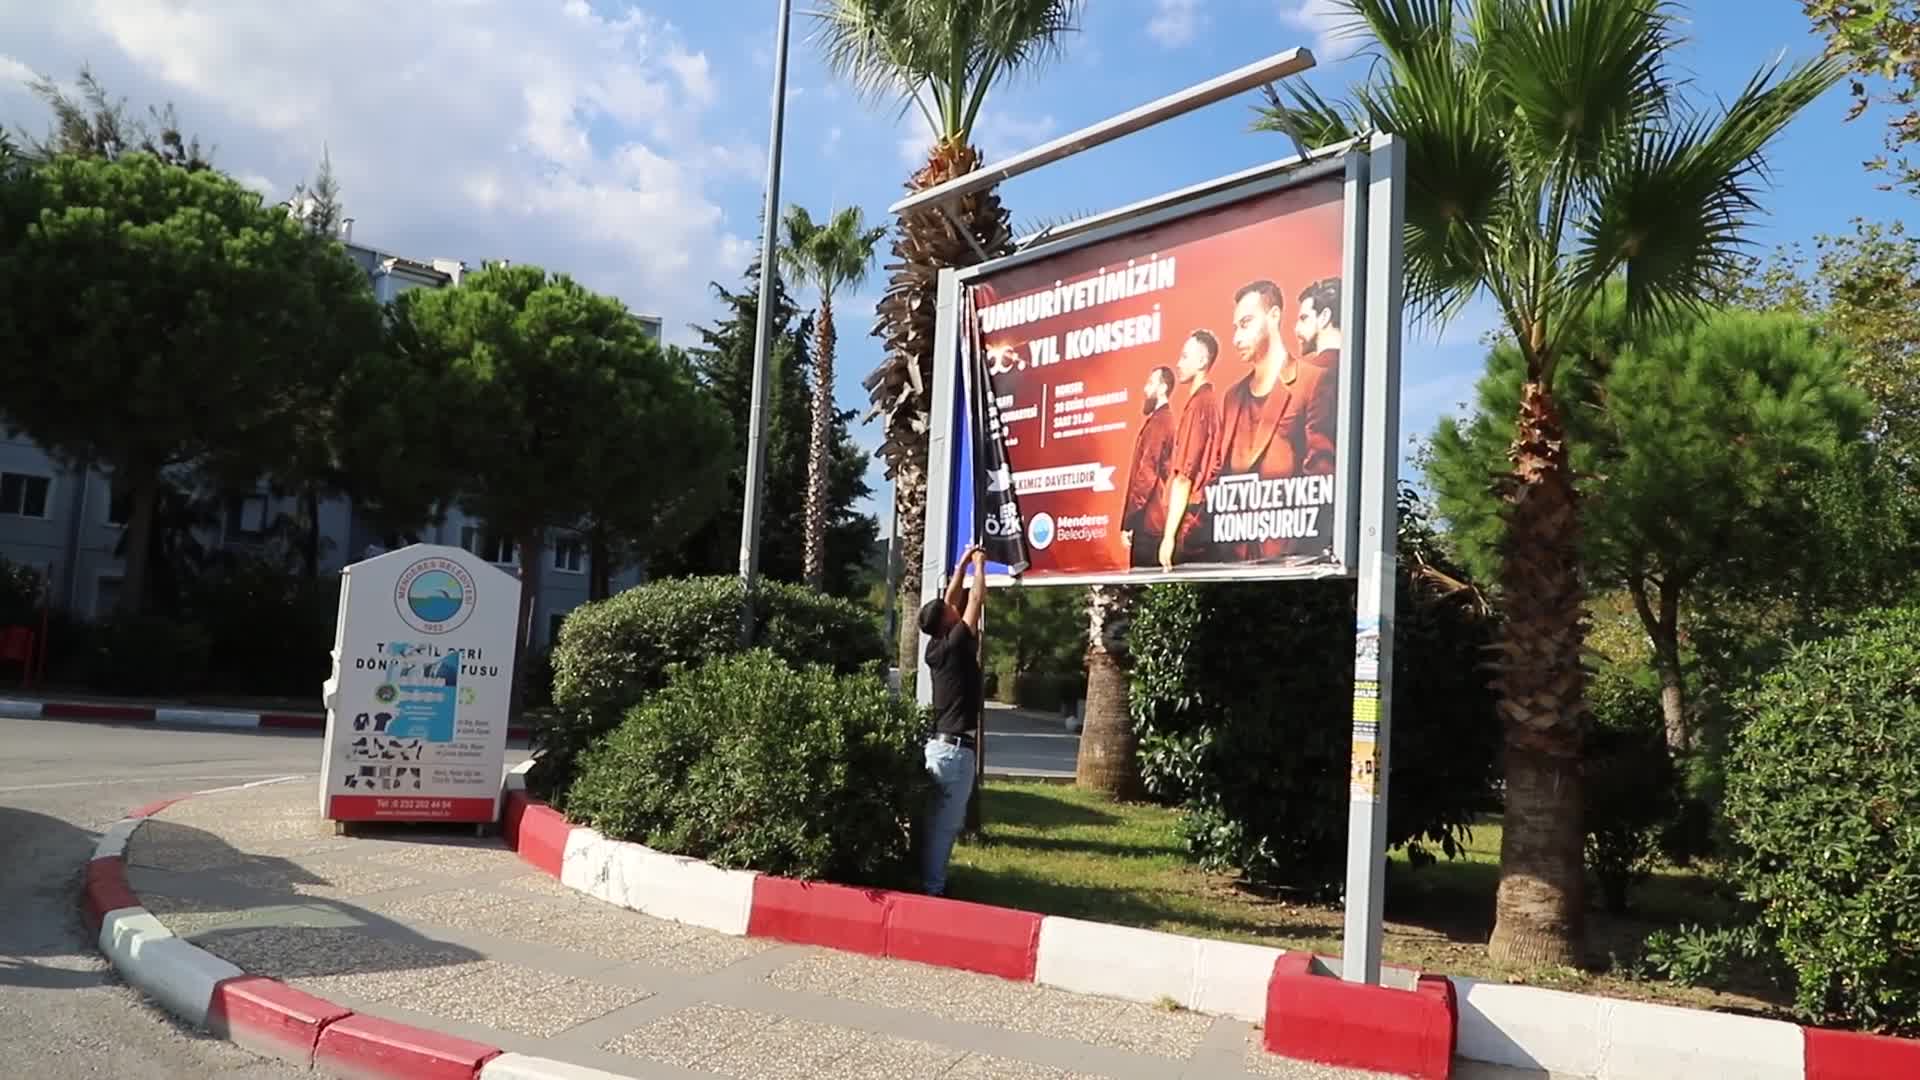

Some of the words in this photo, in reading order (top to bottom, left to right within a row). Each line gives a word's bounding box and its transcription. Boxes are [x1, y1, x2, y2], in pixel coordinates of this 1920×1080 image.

[1028, 335, 1060, 368] YIL
[1065, 304, 1161, 360] KONSERİ
[1057, 514, 1109, 528] Menderes
[1057, 526, 1107, 542] Belediyesi
[1213, 506, 1319, 543] KONUŞURUZ
